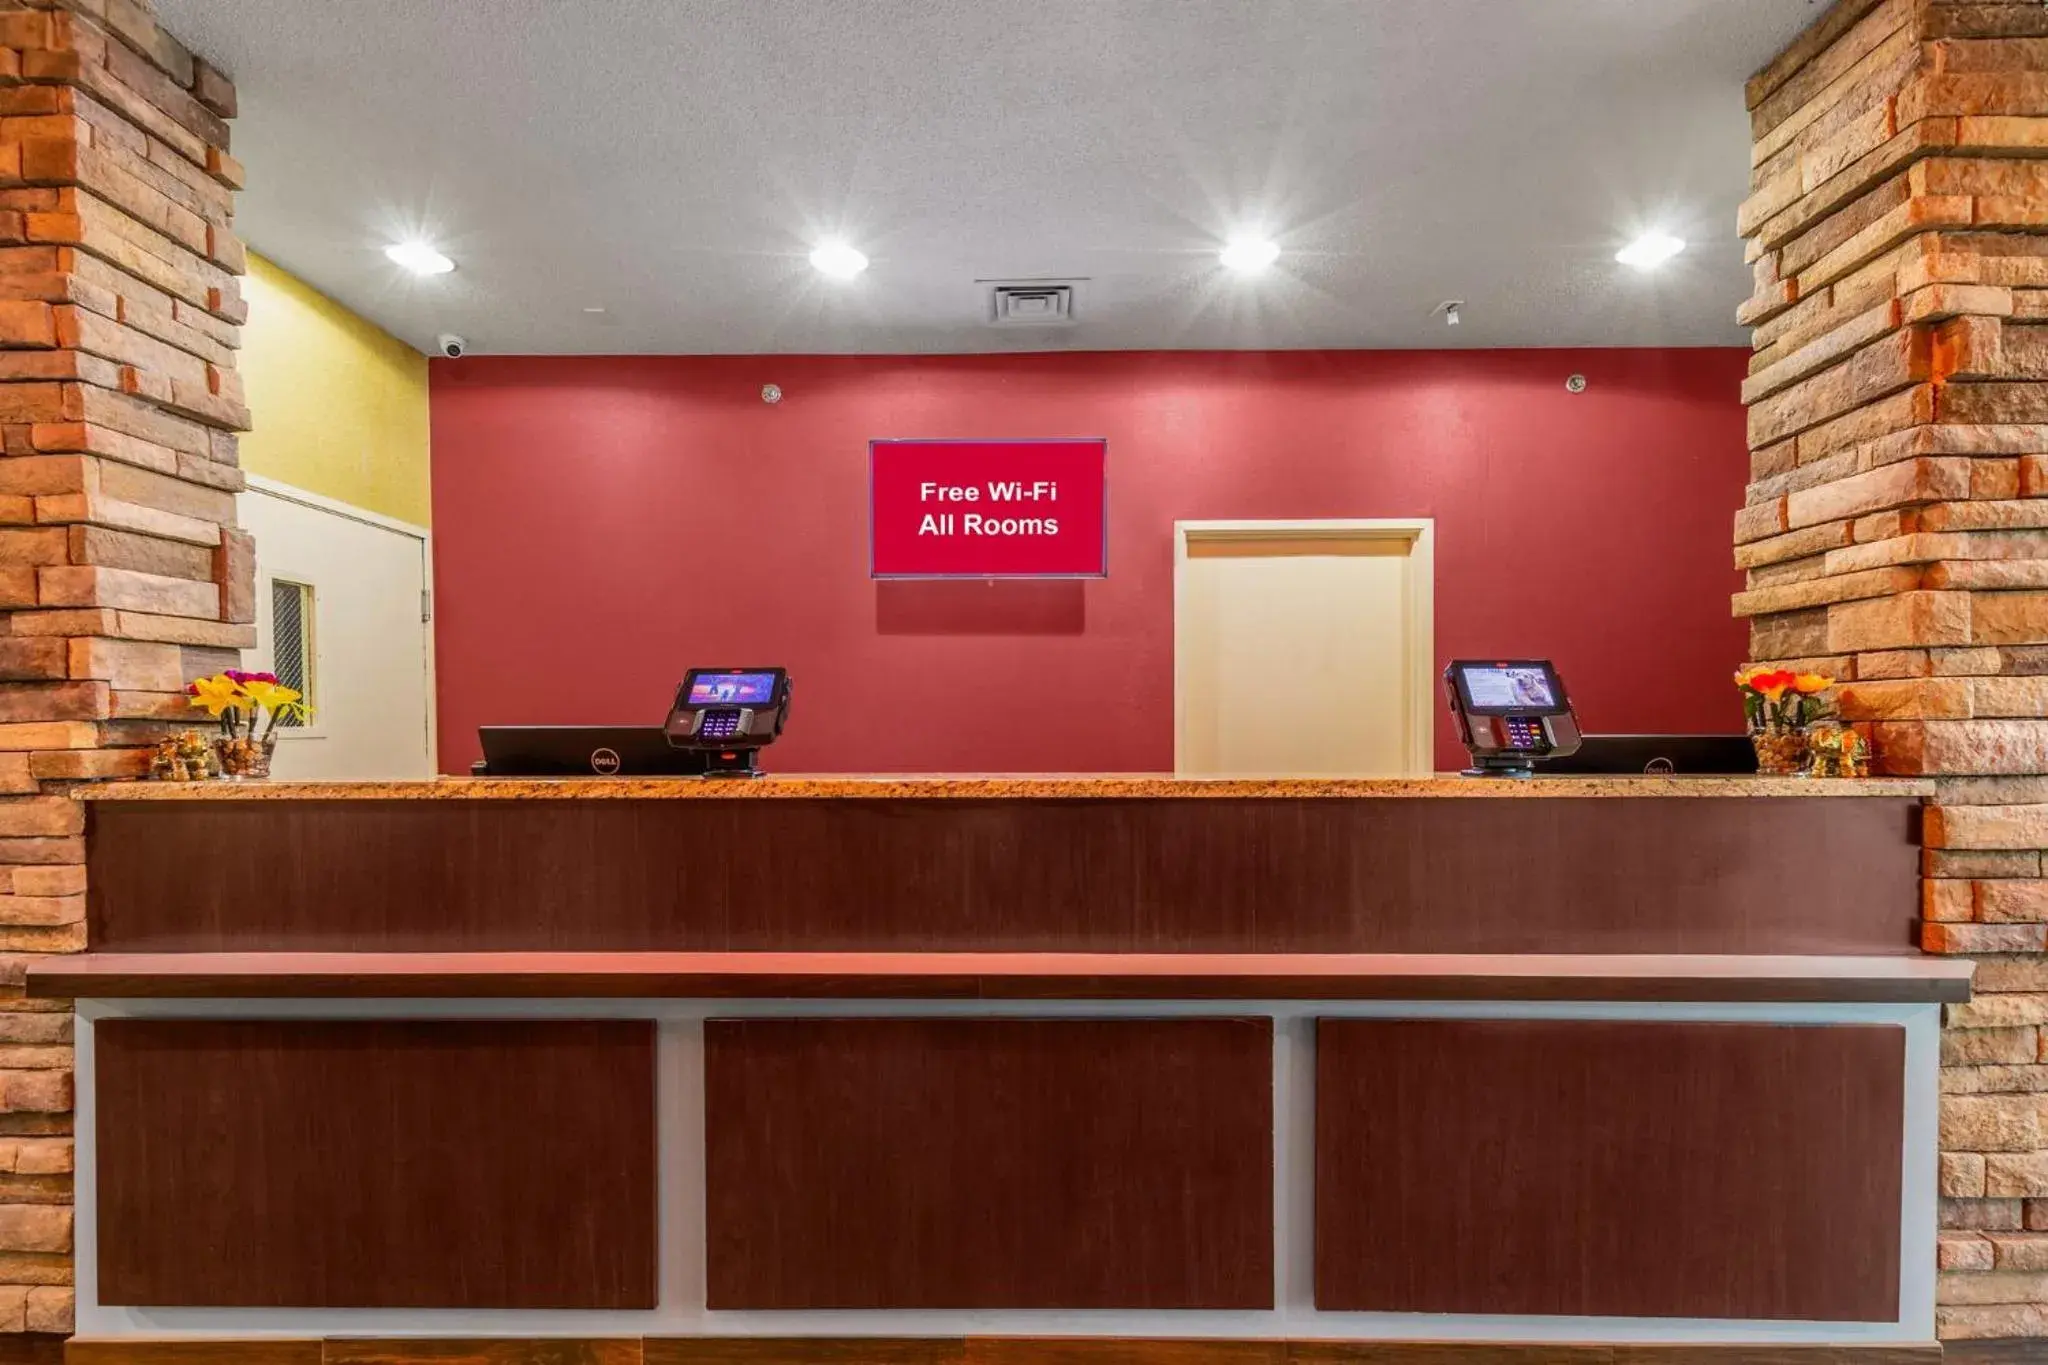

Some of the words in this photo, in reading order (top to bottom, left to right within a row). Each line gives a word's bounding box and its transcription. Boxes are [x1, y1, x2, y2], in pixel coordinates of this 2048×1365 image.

[920, 482, 980, 502] Free
[987, 481, 1057, 501] Wi-Fi
[918, 513, 954, 536] All
[964, 513, 1059, 536] Rooms
[594, 757, 617, 766] DELL
